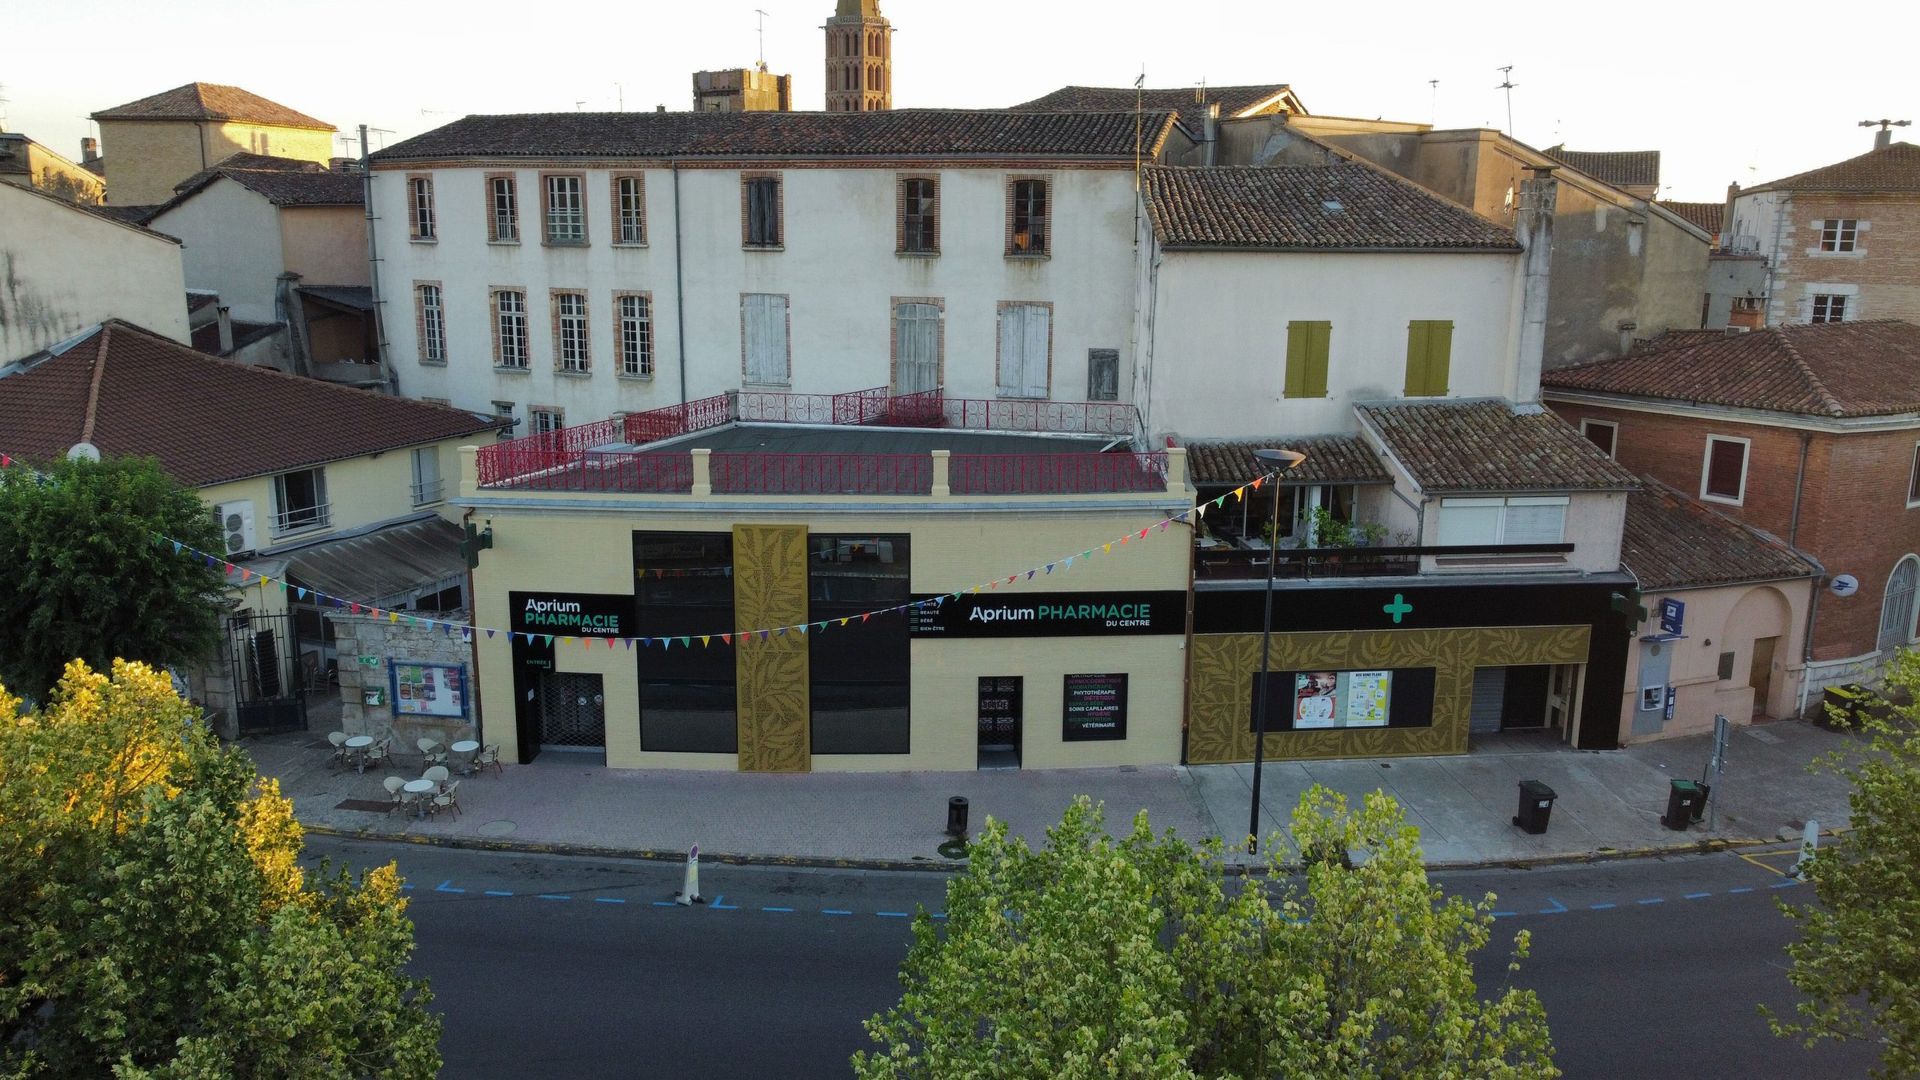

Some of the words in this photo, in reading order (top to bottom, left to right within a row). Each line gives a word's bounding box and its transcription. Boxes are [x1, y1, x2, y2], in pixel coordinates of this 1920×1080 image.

[525, 599, 580, 613] Aprium
[525, 612, 619, 627] PHARMACIE
[969, 605, 1034, 623] Aprium
[1038, 604, 1151, 620] PHARMACIE
[1119, 619, 1151, 627] CENTRE
